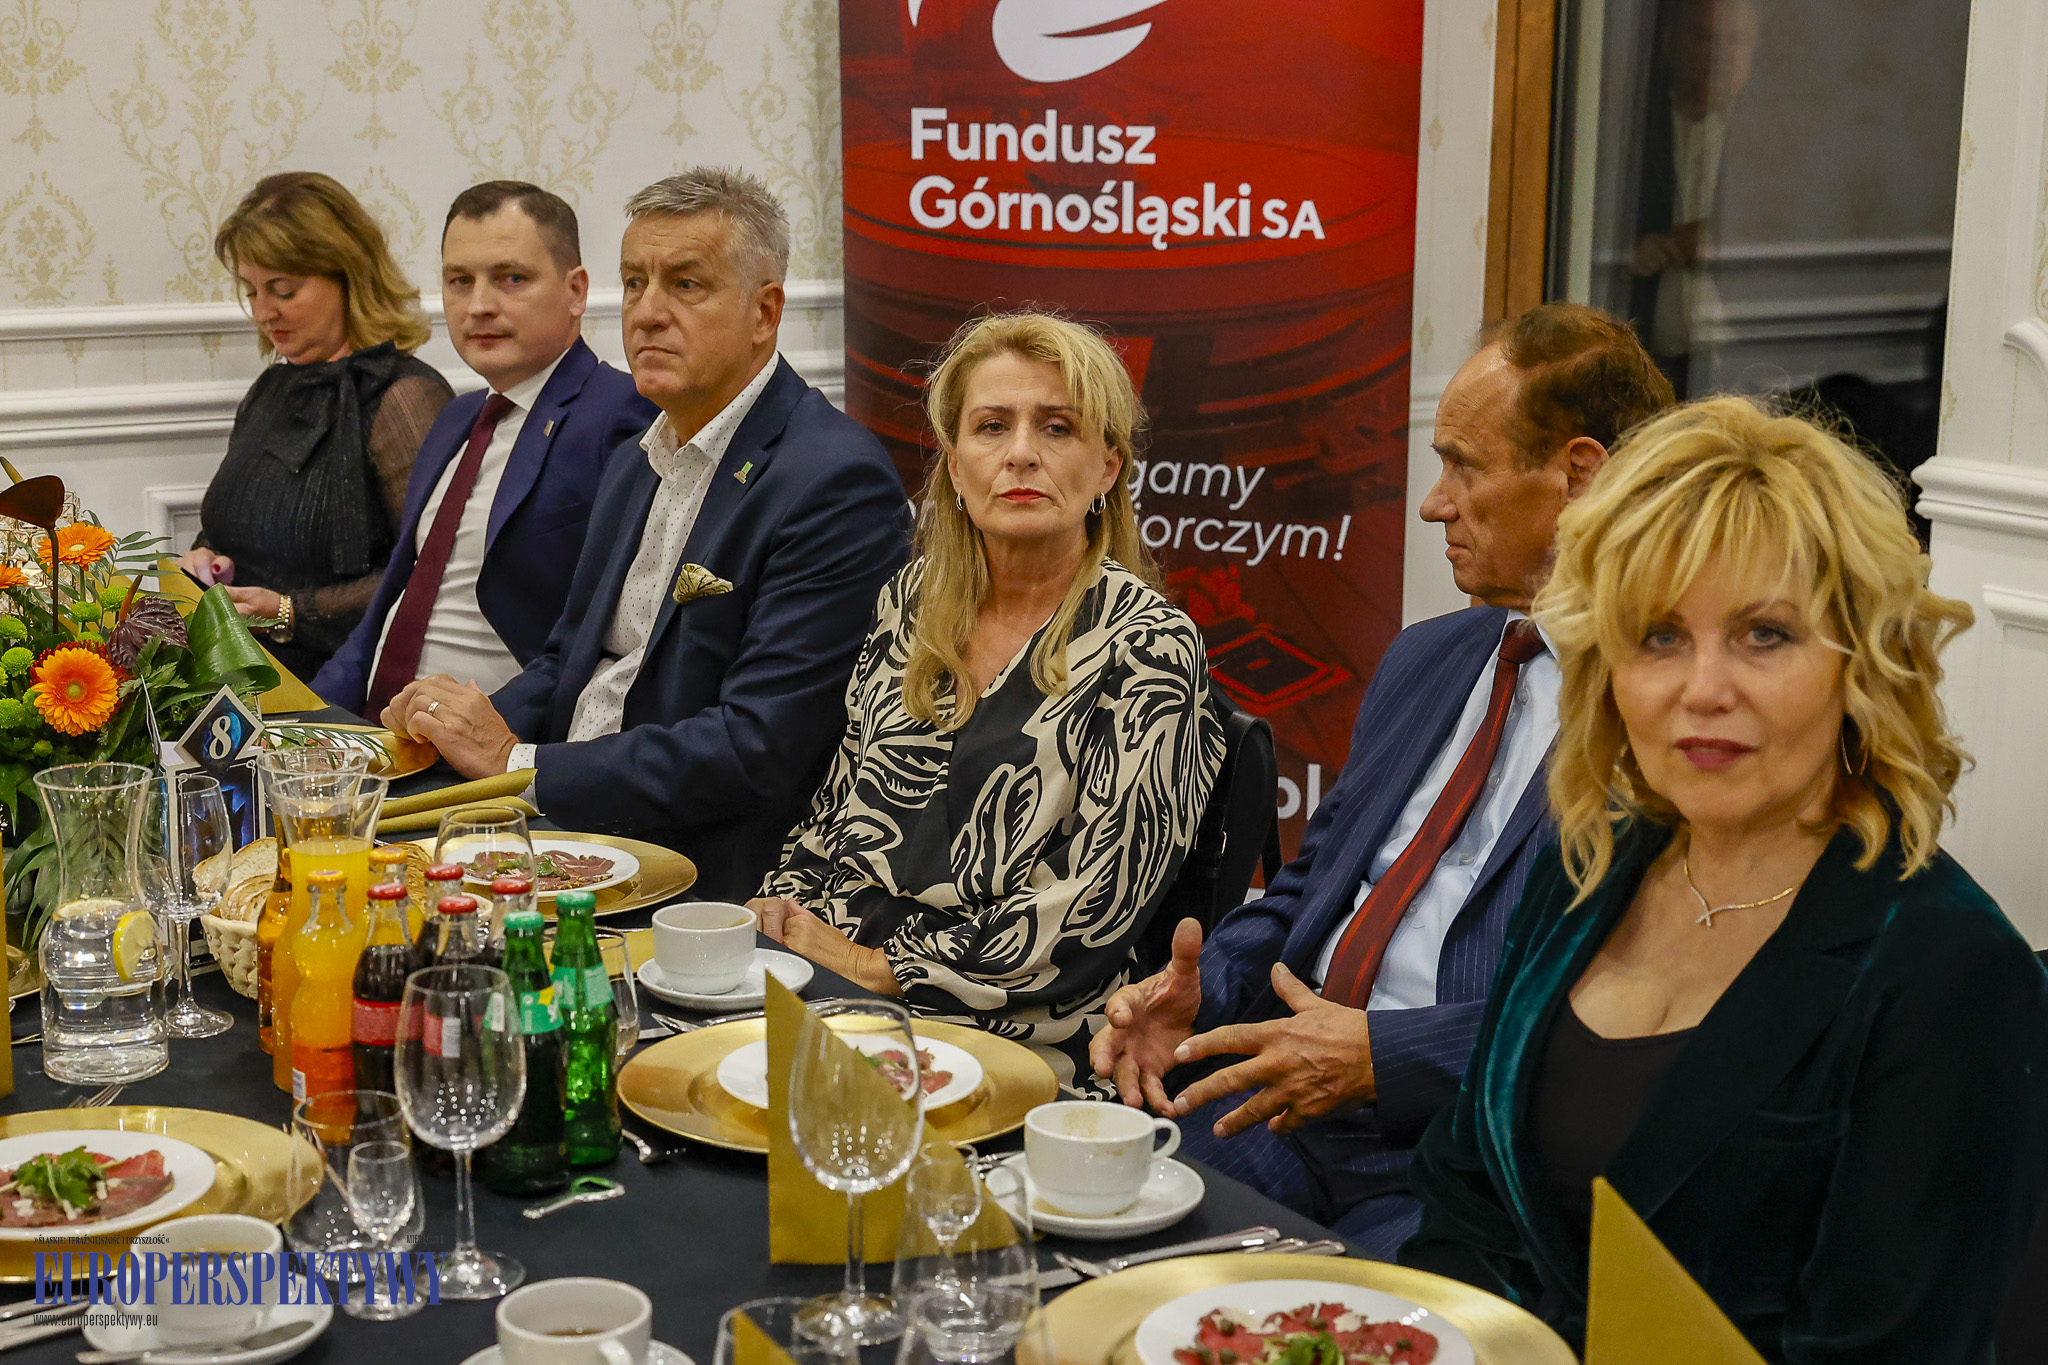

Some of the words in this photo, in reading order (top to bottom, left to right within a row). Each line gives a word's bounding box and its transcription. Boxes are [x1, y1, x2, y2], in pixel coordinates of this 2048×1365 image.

[910, 107, 1156, 164] Fundusz
[908, 174, 1251, 251] Górnośląski
[1261, 199, 1326, 241] SA
[209, 715, 231, 759] 8
